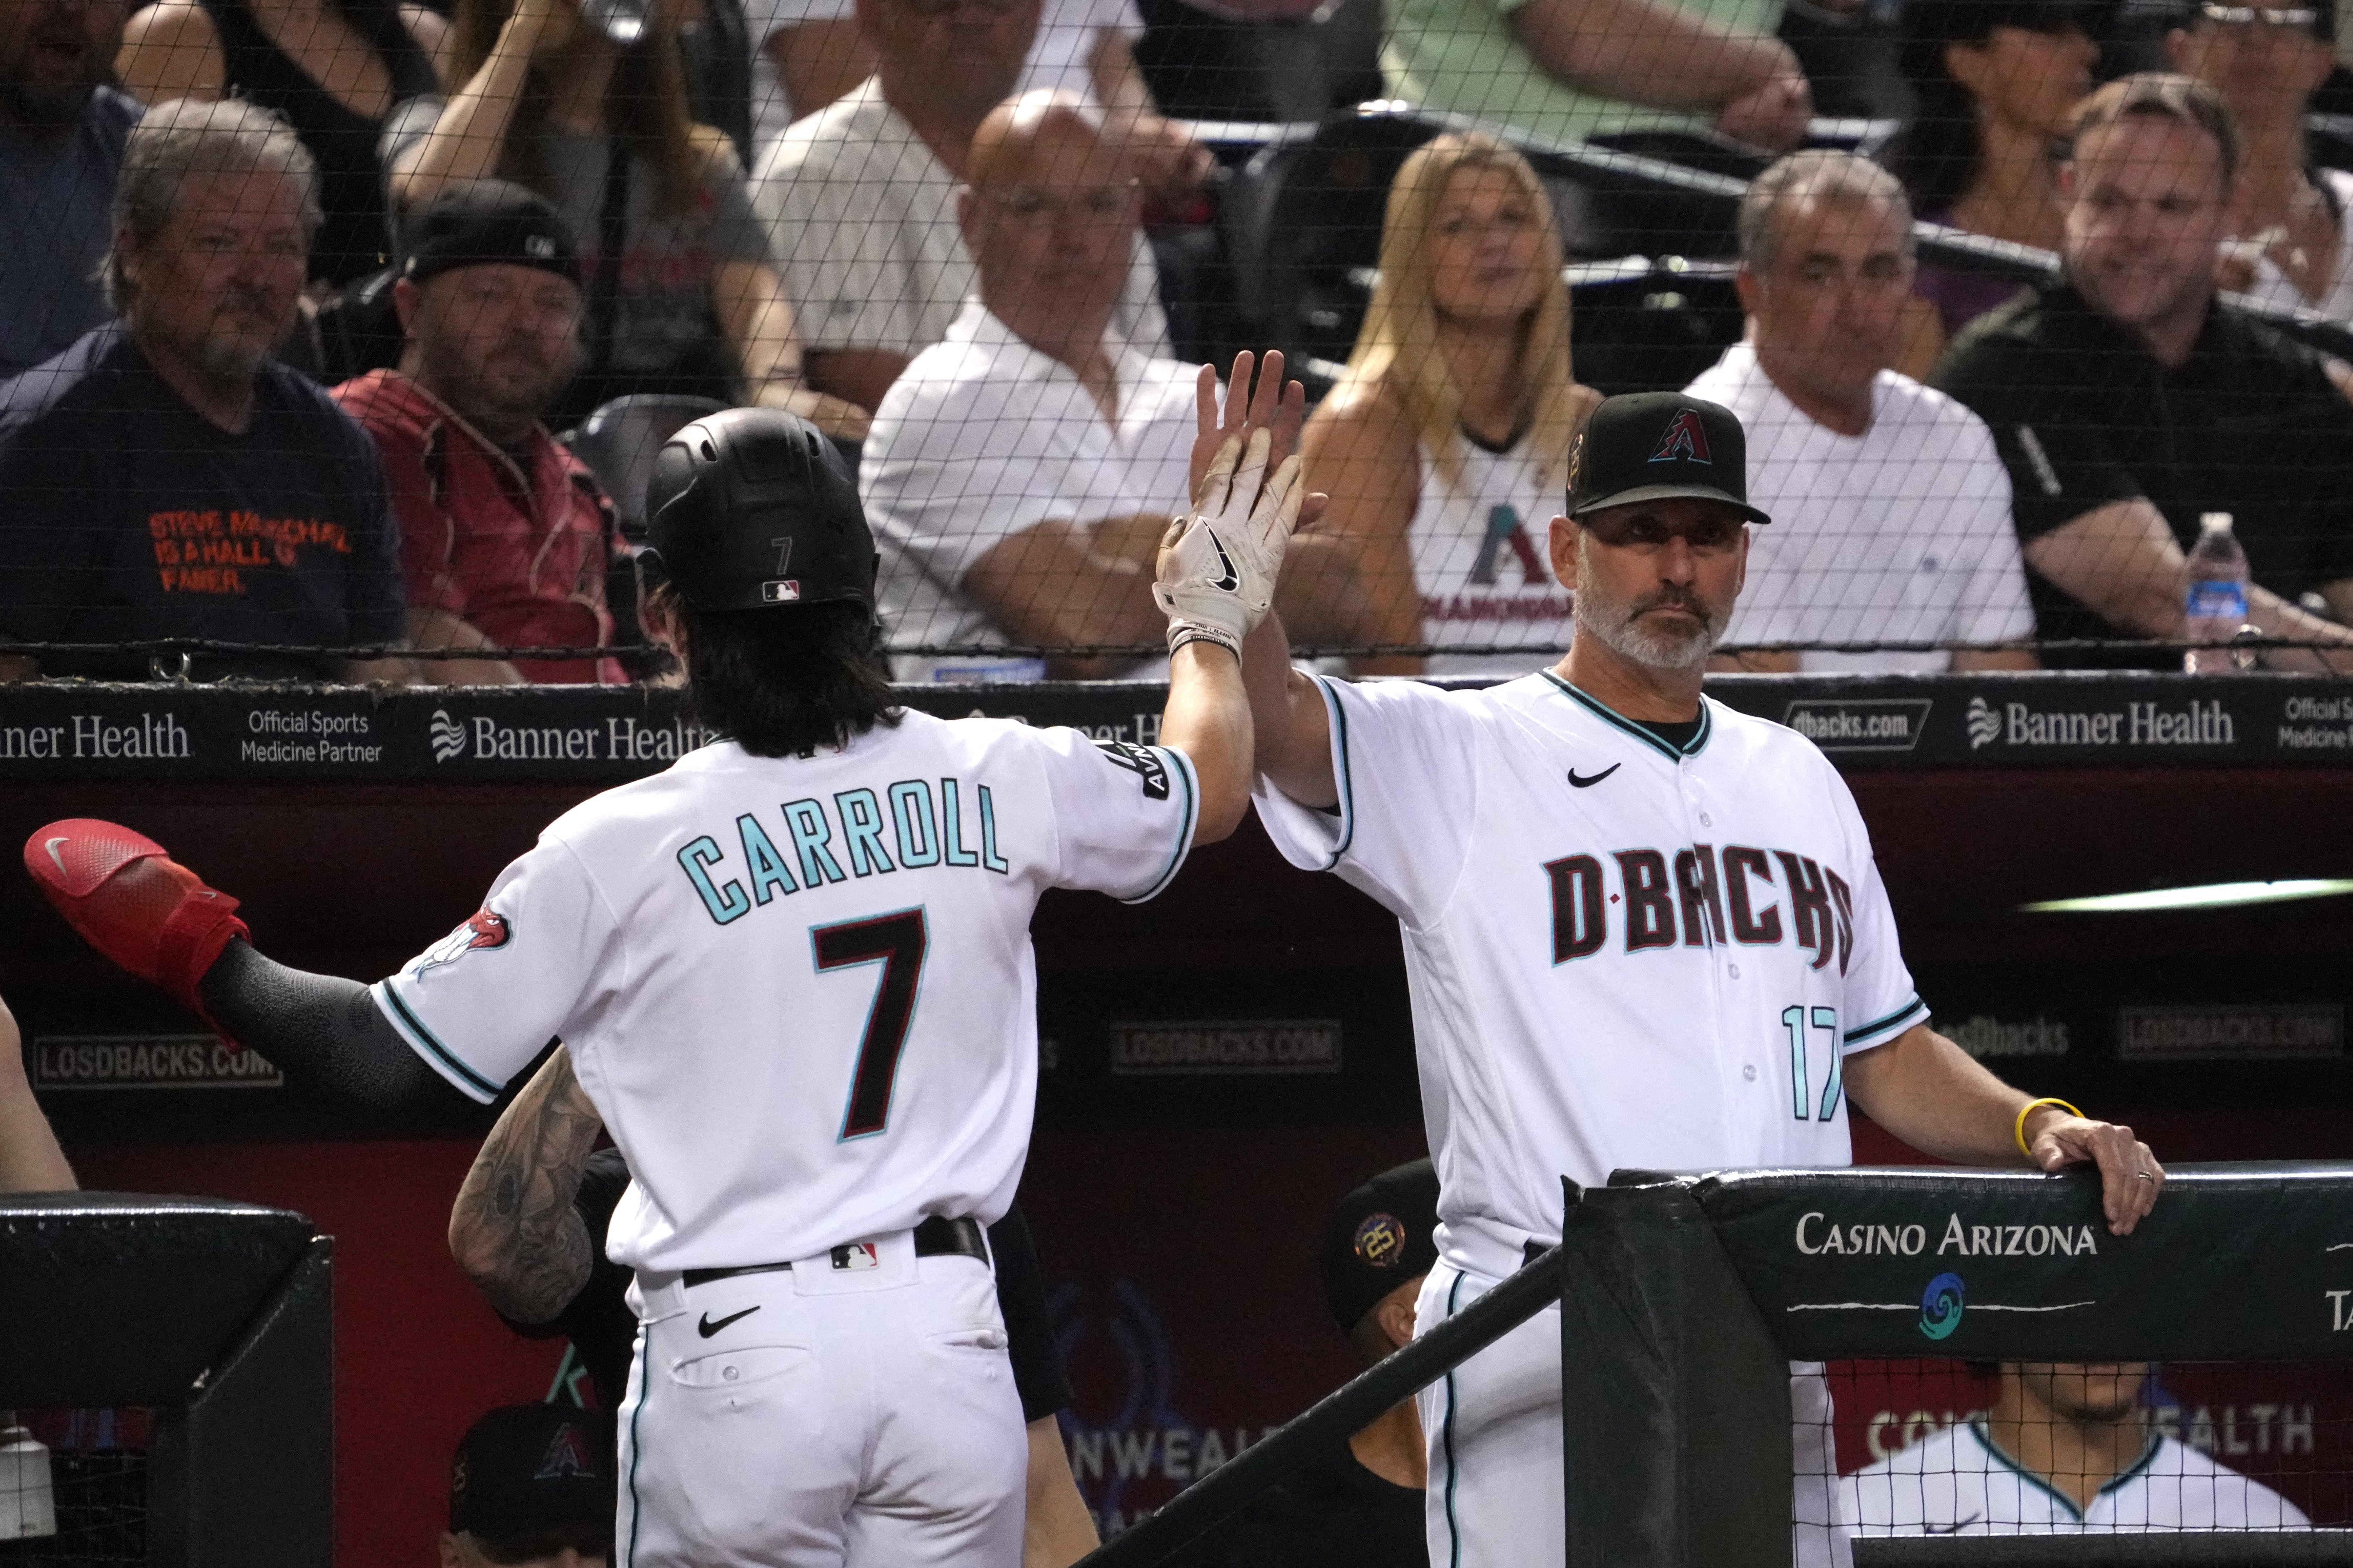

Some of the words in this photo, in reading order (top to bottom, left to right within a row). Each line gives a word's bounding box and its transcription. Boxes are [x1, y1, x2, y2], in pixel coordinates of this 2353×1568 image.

[203, 539, 271, 566] HALL
[771, 536, 792, 575] 7
[249, 710, 308, 733] Official
[312, 710, 369, 739] Sports
[2006, 703, 2124, 745] Banner
[2128, 700, 2234, 745] Health
[2285, 696, 2340, 720] Official
[0, 727, 64, 758] ner
[71, 713, 192, 758] Health
[241, 740, 316, 762] Medicine
[320, 740, 383, 762] Partner
[472, 717, 599, 759] Banner
[2277, 726, 2347, 747] Medicine
[677, 778, 1008, 926] CARROLL
[808, 904, 931, 1144] 7
[1782, 1005, 1842, 1122] 17
[1362, 1222, 1396, 1258] 25
[1795, 1212, 1926, 1255] CASINO
[1937, 1213, 2098, 1256] ARIZONA
